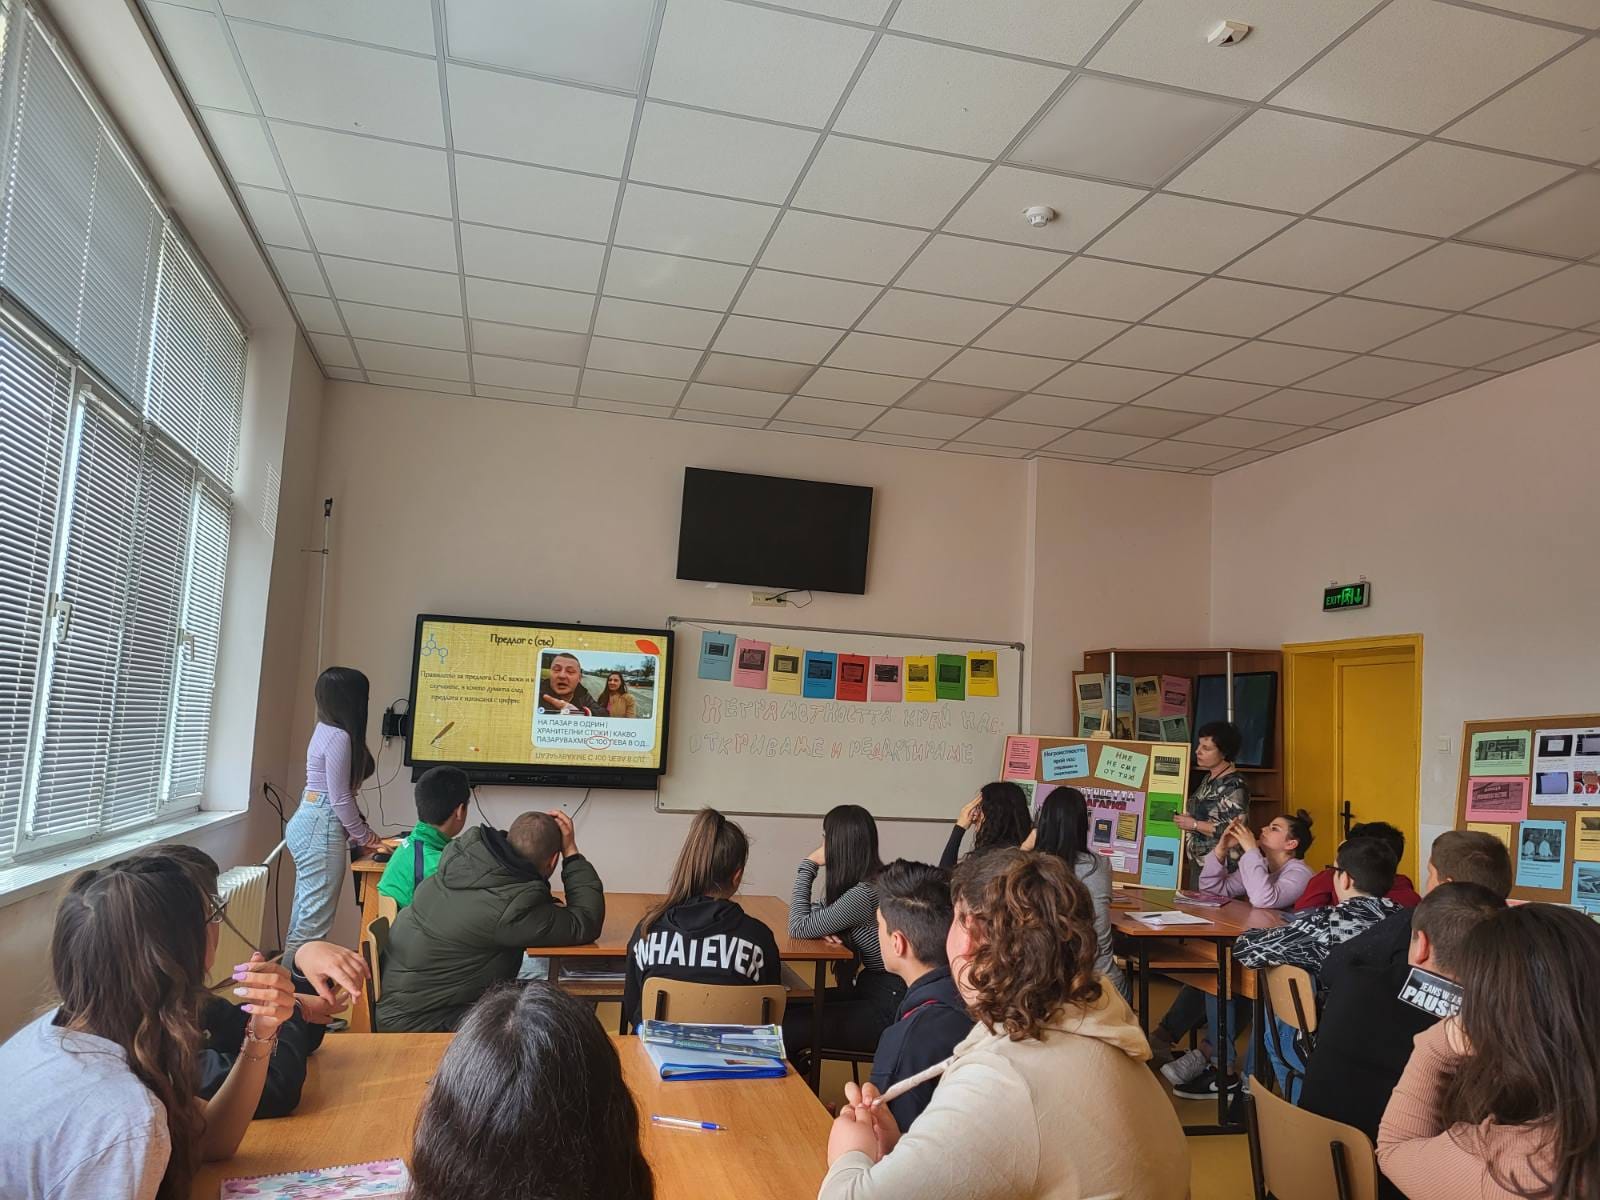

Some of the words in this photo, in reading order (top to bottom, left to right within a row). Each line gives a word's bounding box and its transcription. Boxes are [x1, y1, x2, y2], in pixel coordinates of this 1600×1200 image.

[1326, 595, 1341, 606] EXIT
[490, 633, 526, 646] Предлог
[535, 635, 554, 647] (със)
[493, 674, 508, 682] СЪС
[702, 694, 892, 725] НЕГРАМОТНОСТТА
[904, 703, 951, 730] КРАЙ
[579, 720, 605, 728] ОДРИН
[537, 727, 583, 735] ХРАНИТЕЛНИ
[584, 729, 609, 737] СТОКИ
[536, 736, 587, 744] ПАЗАРУВАХМЕ
[1120, 763, 1137, 772] СМЕ
[633, 931, 764, 982] WHATEVER
[1419, 981, 1442, 998] JEANS
